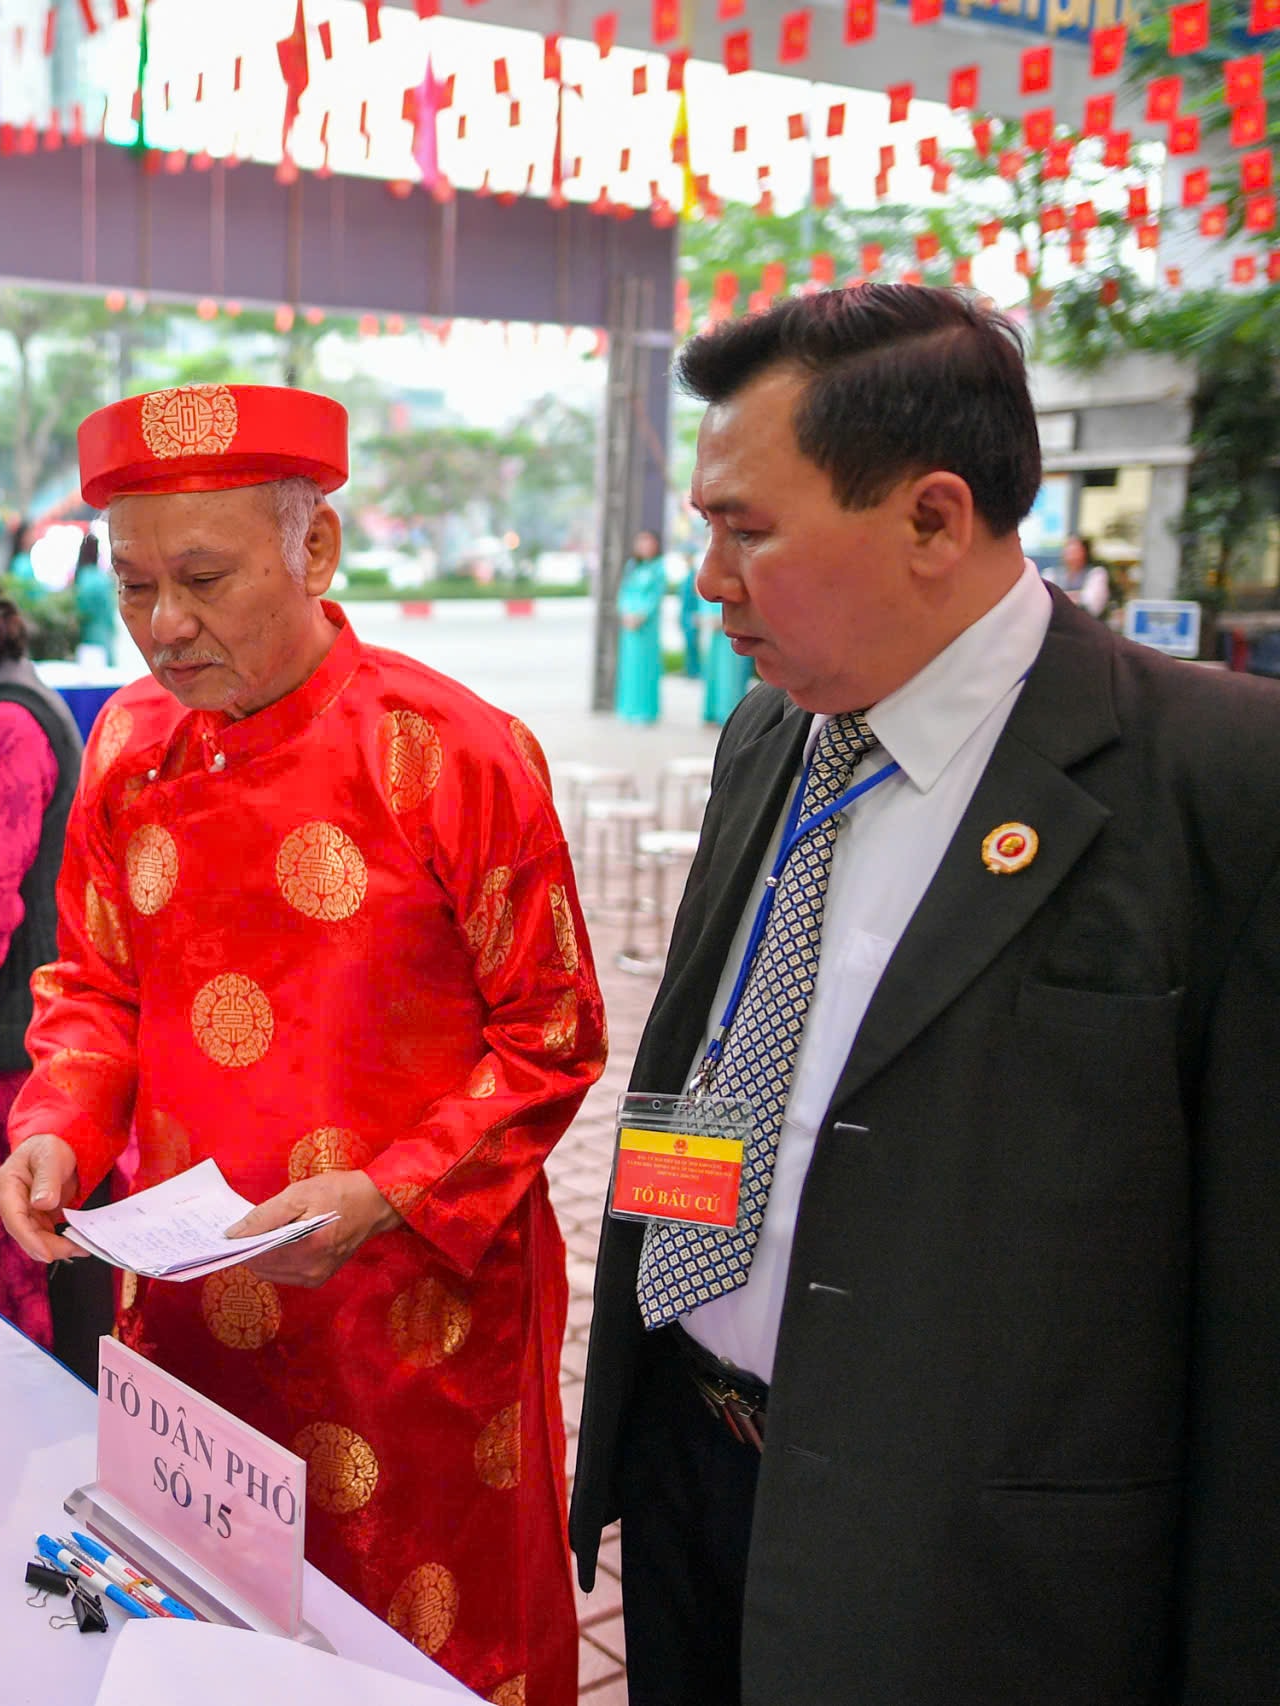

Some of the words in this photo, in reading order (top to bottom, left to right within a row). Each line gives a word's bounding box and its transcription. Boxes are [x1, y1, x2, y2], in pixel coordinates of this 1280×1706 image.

[632, 1184, 654, 1203] TỔ
[658, 1186, 691, 1208] BẦU
[695, 1193, 720, 1212] CỬ
[102, 1365, 140, 1417] TỔ
[150, 1396, 215, 1472] DÂN
[225, 1448, 296, 1525] PHỐ
[153, 1456, 192, 1508] SỐ
[202, 1493, 232, 1539] 15
